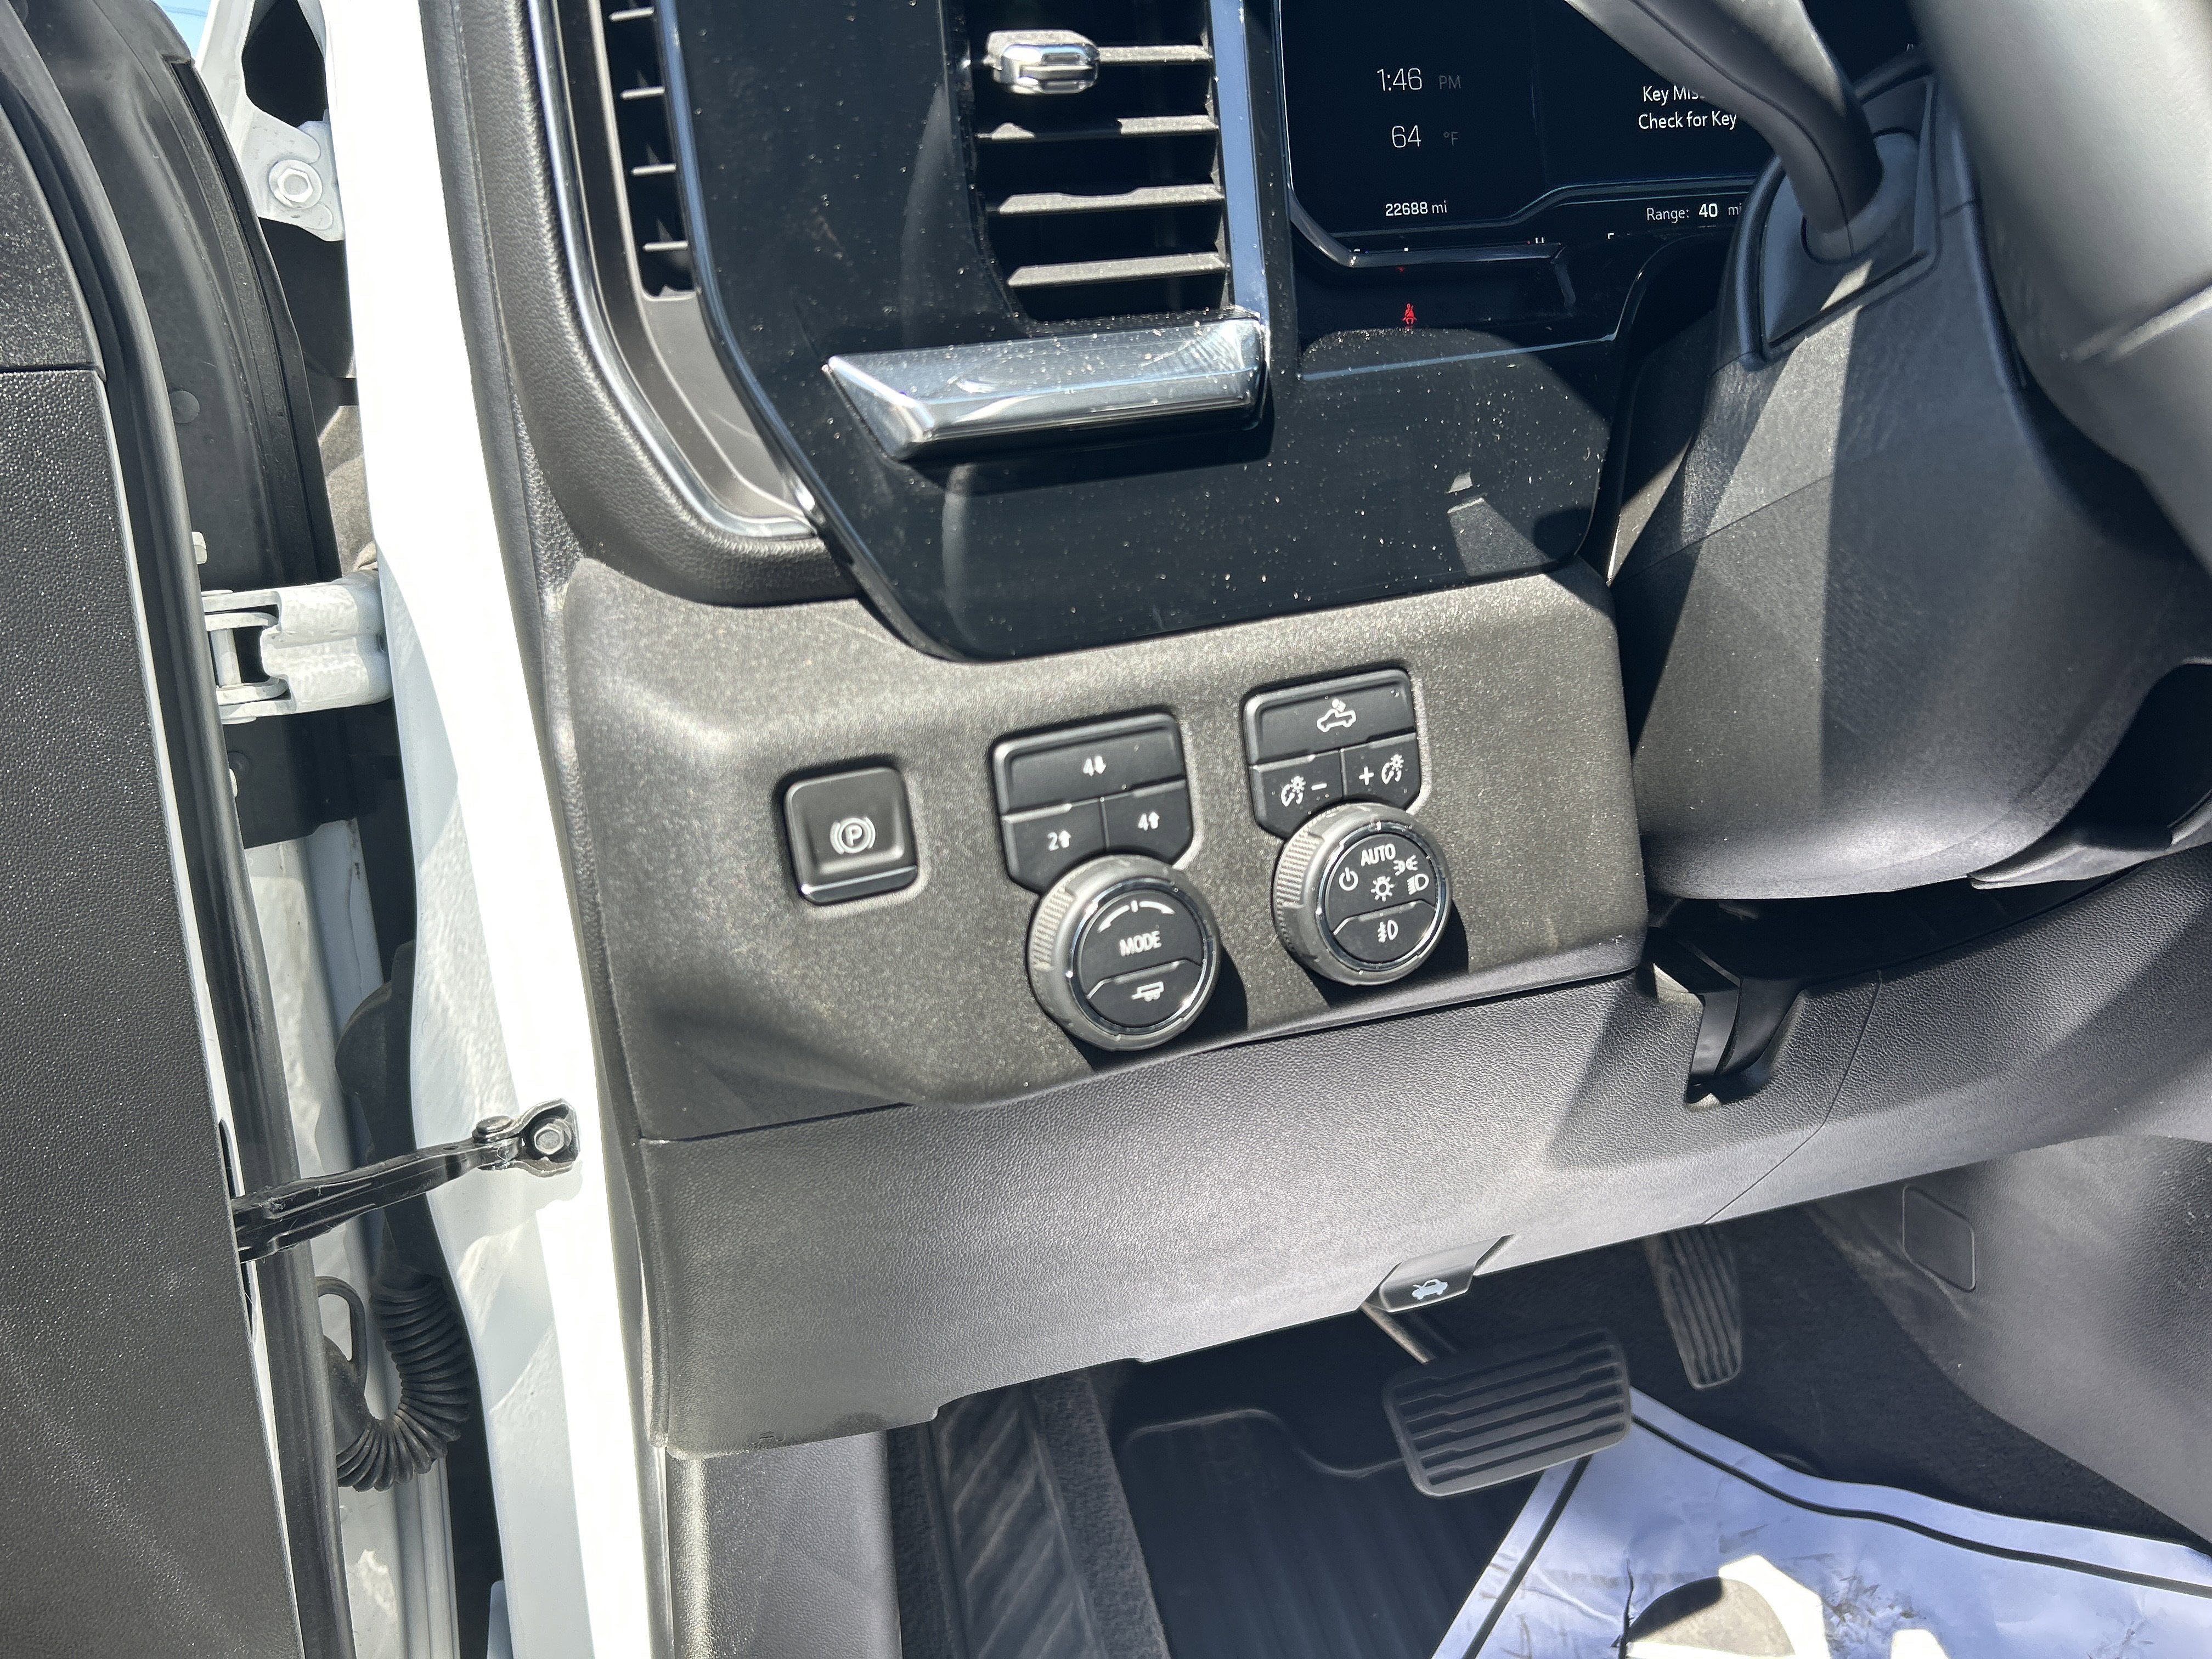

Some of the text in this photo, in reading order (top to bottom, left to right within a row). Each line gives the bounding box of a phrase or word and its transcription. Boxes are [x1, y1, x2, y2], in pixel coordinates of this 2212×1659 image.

[1377, 68, 1462, 91] 1:46 PM
[1643, 86, 1669, 106] Key
[1638, 110, 1737, 130] Check for Key
[1392, 125, 1421, 148] 64
[1386, 200, 1447, 216] 22688 mi
[1646, 207, 1690, 224] Range:
[1699, 203, 1718, 218] 40
[845, 825, 863, 846] P
[1361, 843, 1396, 867] AUTO
[1120, 930, 1162, 957] MODE
